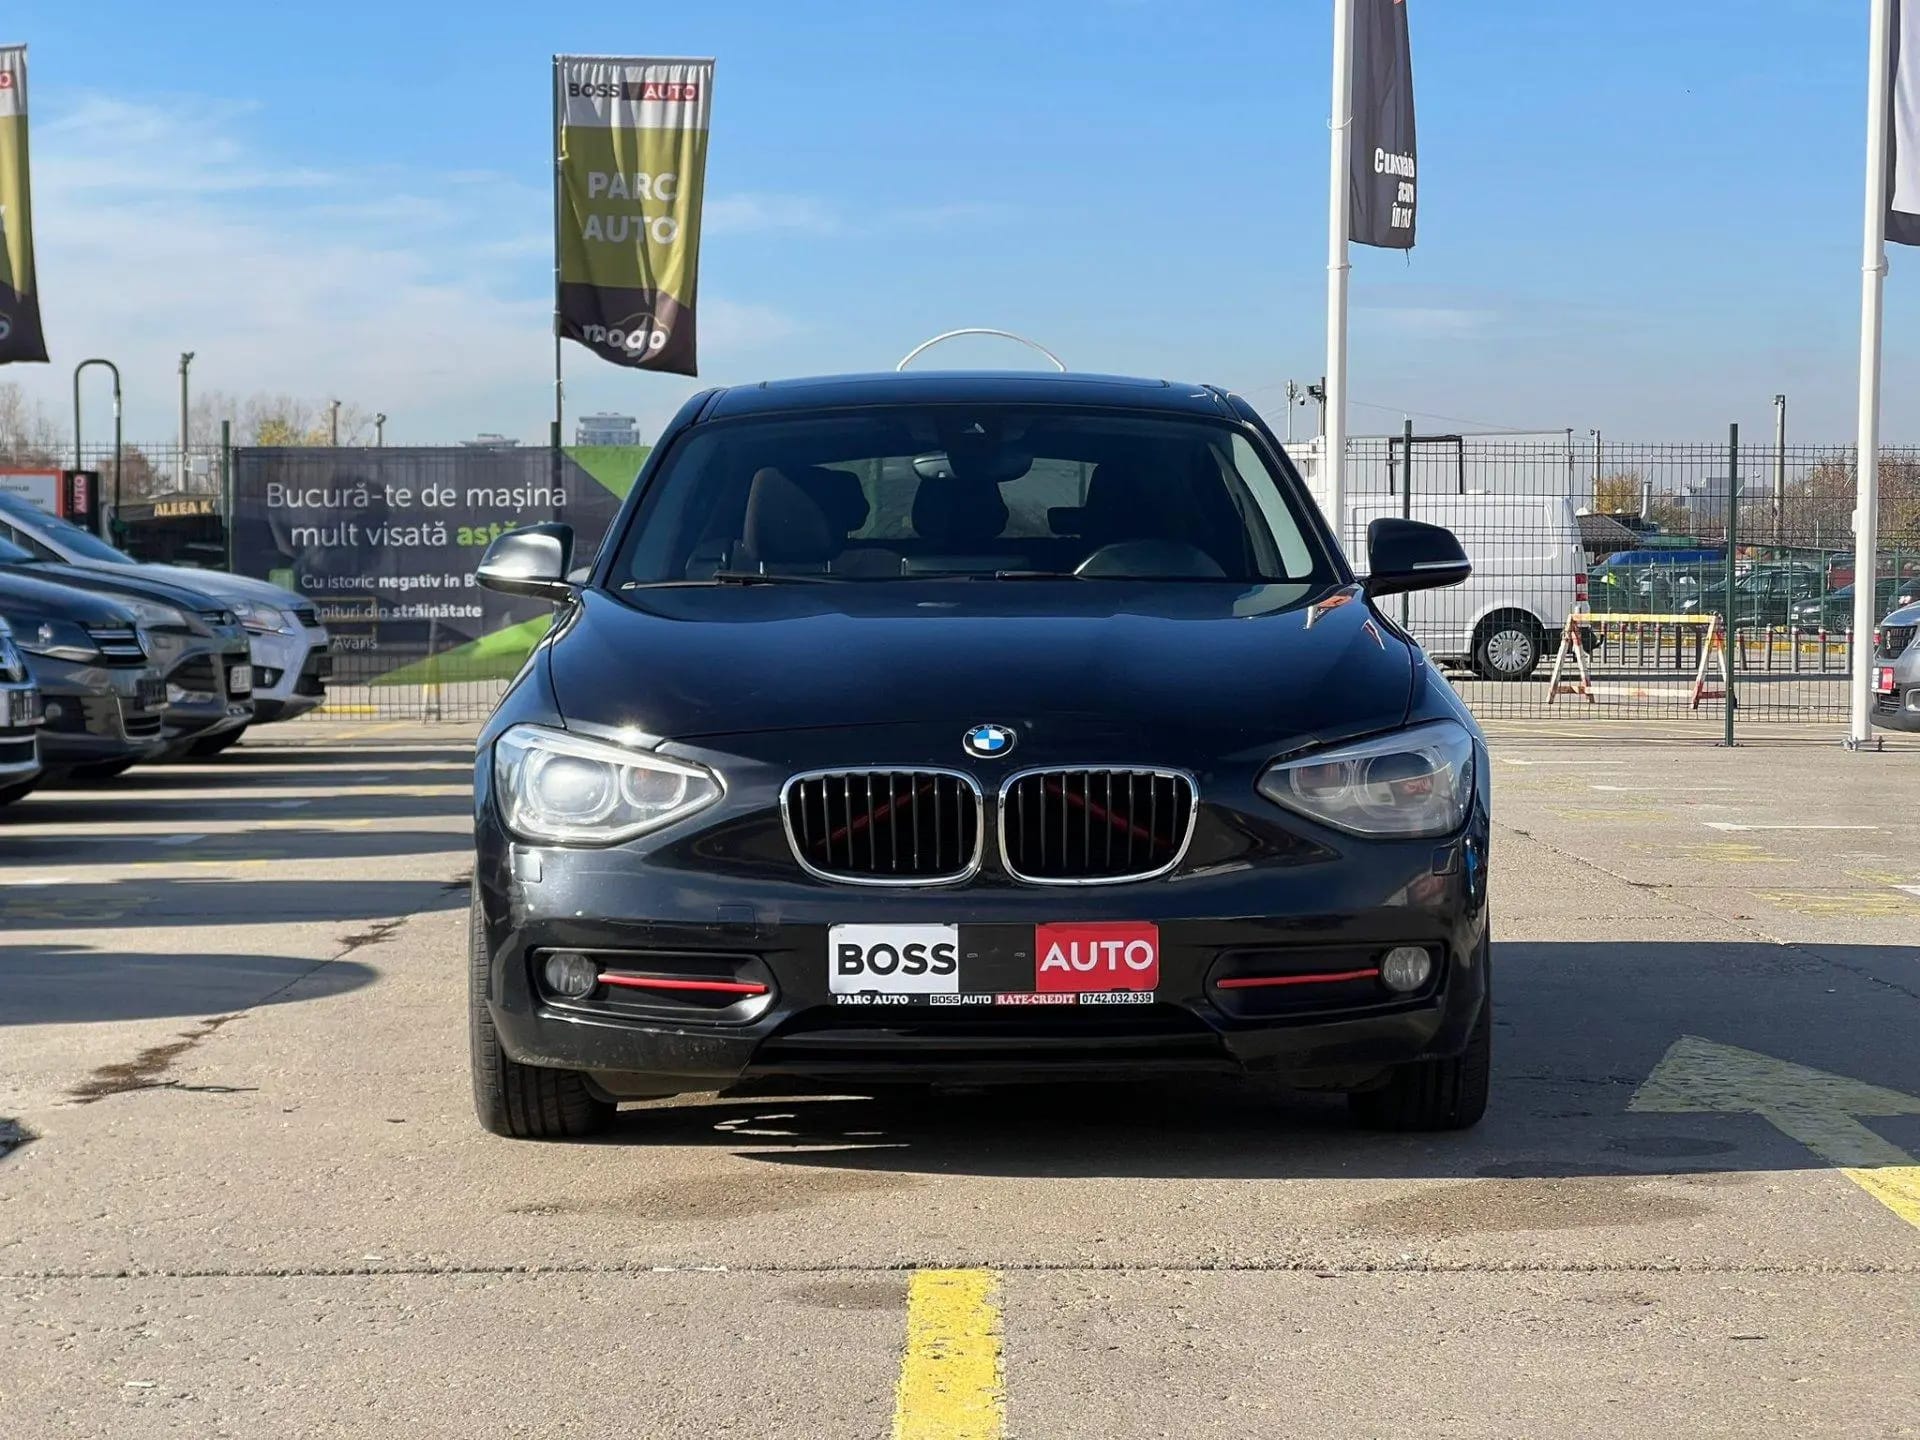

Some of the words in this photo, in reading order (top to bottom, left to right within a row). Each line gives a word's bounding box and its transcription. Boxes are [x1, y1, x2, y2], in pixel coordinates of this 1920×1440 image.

[569, 83, 620, 98] BOSS
[644, 84, 696, 99] AUTO
[587, 172, 677, 200] PARC
[582, 215, 679, 244] AUTO
[582, 323, 666, 358] mogo
[74, 474, 89, 514] AUTO
[267, 483, 411, 508] Bucură-te
[421, 482, 457, 508] de
[466, 482, 567, 513] mașina
[291, 521, 358, 547] mult
[366, 521, 447, 547] visată
[301, 574, 323, 588] Cu
[328, 574, 375, 588] istoric
[378, 573, 441, 591] negativ
[315, 604, 360, 618] enituri
[364, 604, 389, 618] din
[392, 603, 482, 618] străinătate
[837, 942, 957, 976] BOSS
[1039, 940, 1154, 972] AUTO
[837, 994, 870, 1005] PARC
[871, 994, 909, 1005] AUTO
[931, 995, 959, 1005] BOSS
[962, 995, 991, 1004] AUTO
[996, 994, 1075, 1005] RATE-CREDIT
[1081, 993, 1152, 1004] 0742.032.939
